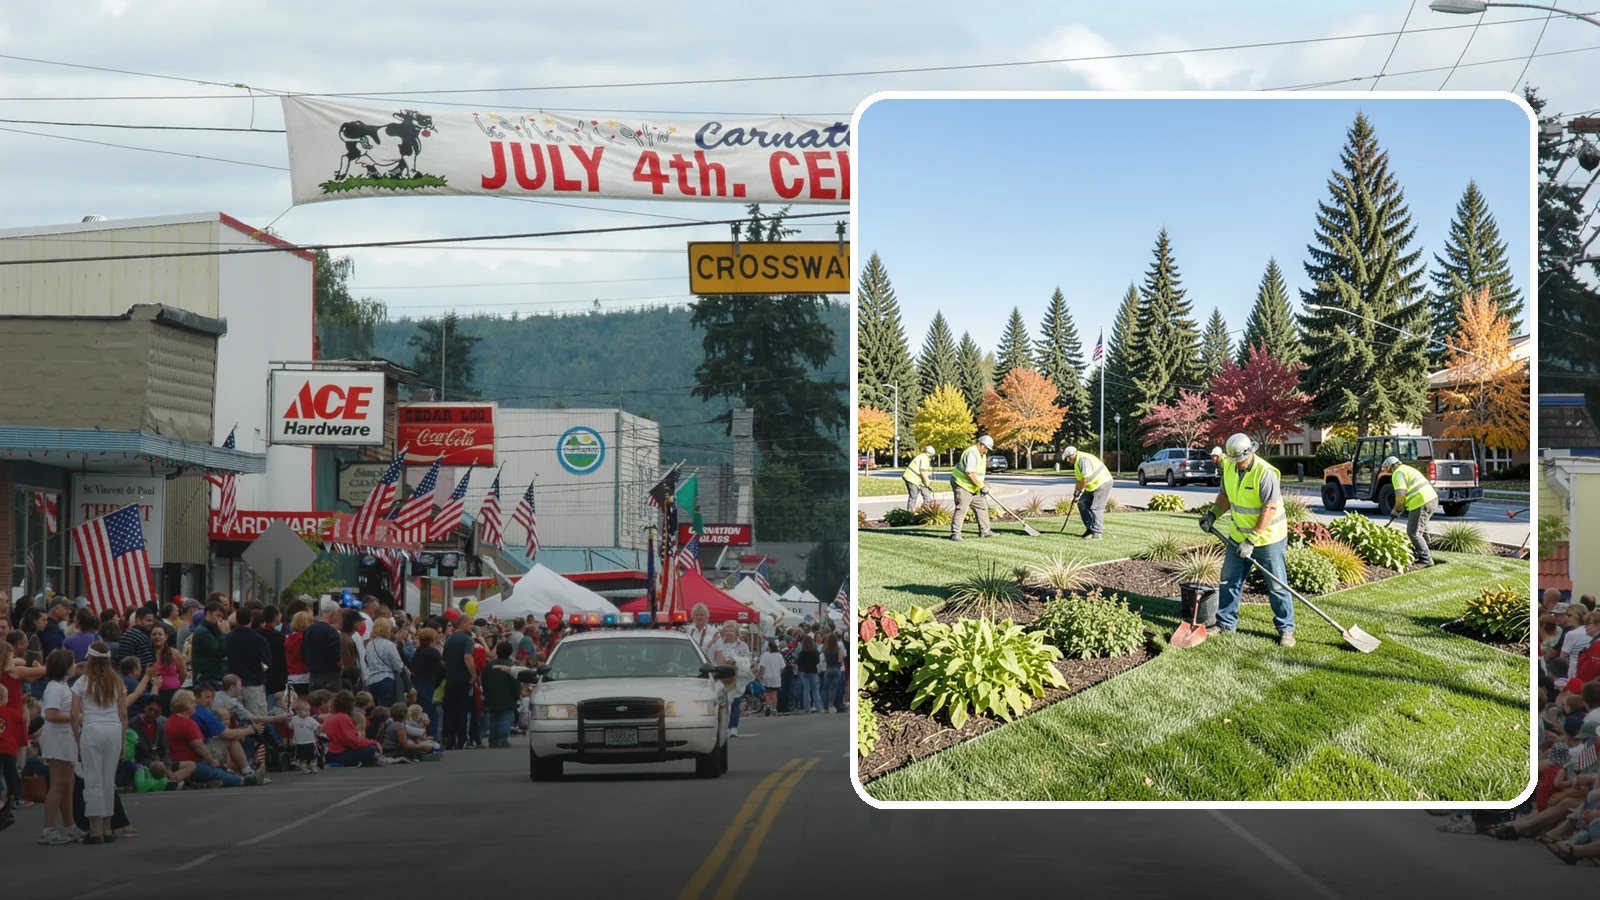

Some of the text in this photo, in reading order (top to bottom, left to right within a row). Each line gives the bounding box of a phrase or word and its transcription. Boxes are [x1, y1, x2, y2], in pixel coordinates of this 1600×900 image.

[695, 121, 850, 149] Carnat
[481, 141, 605, 192] JULY
[633, 149, 746, 198] 4th.
[697, 254, 850, 280] CROSSWA
[283, 380, 373, 420] ACE
[405, 409, 452, 422] CEDAR
[283, 421, 370, 436] Hardware
[416, 428, 477, 447] Coca-Cola
[353, 467, 385, 480] Simpl
[83, 485, 155, 495] St. Vincent de Paul
[688, 526, 741, 535] CRNATION
[699, 535, 730, 544] GLASS
